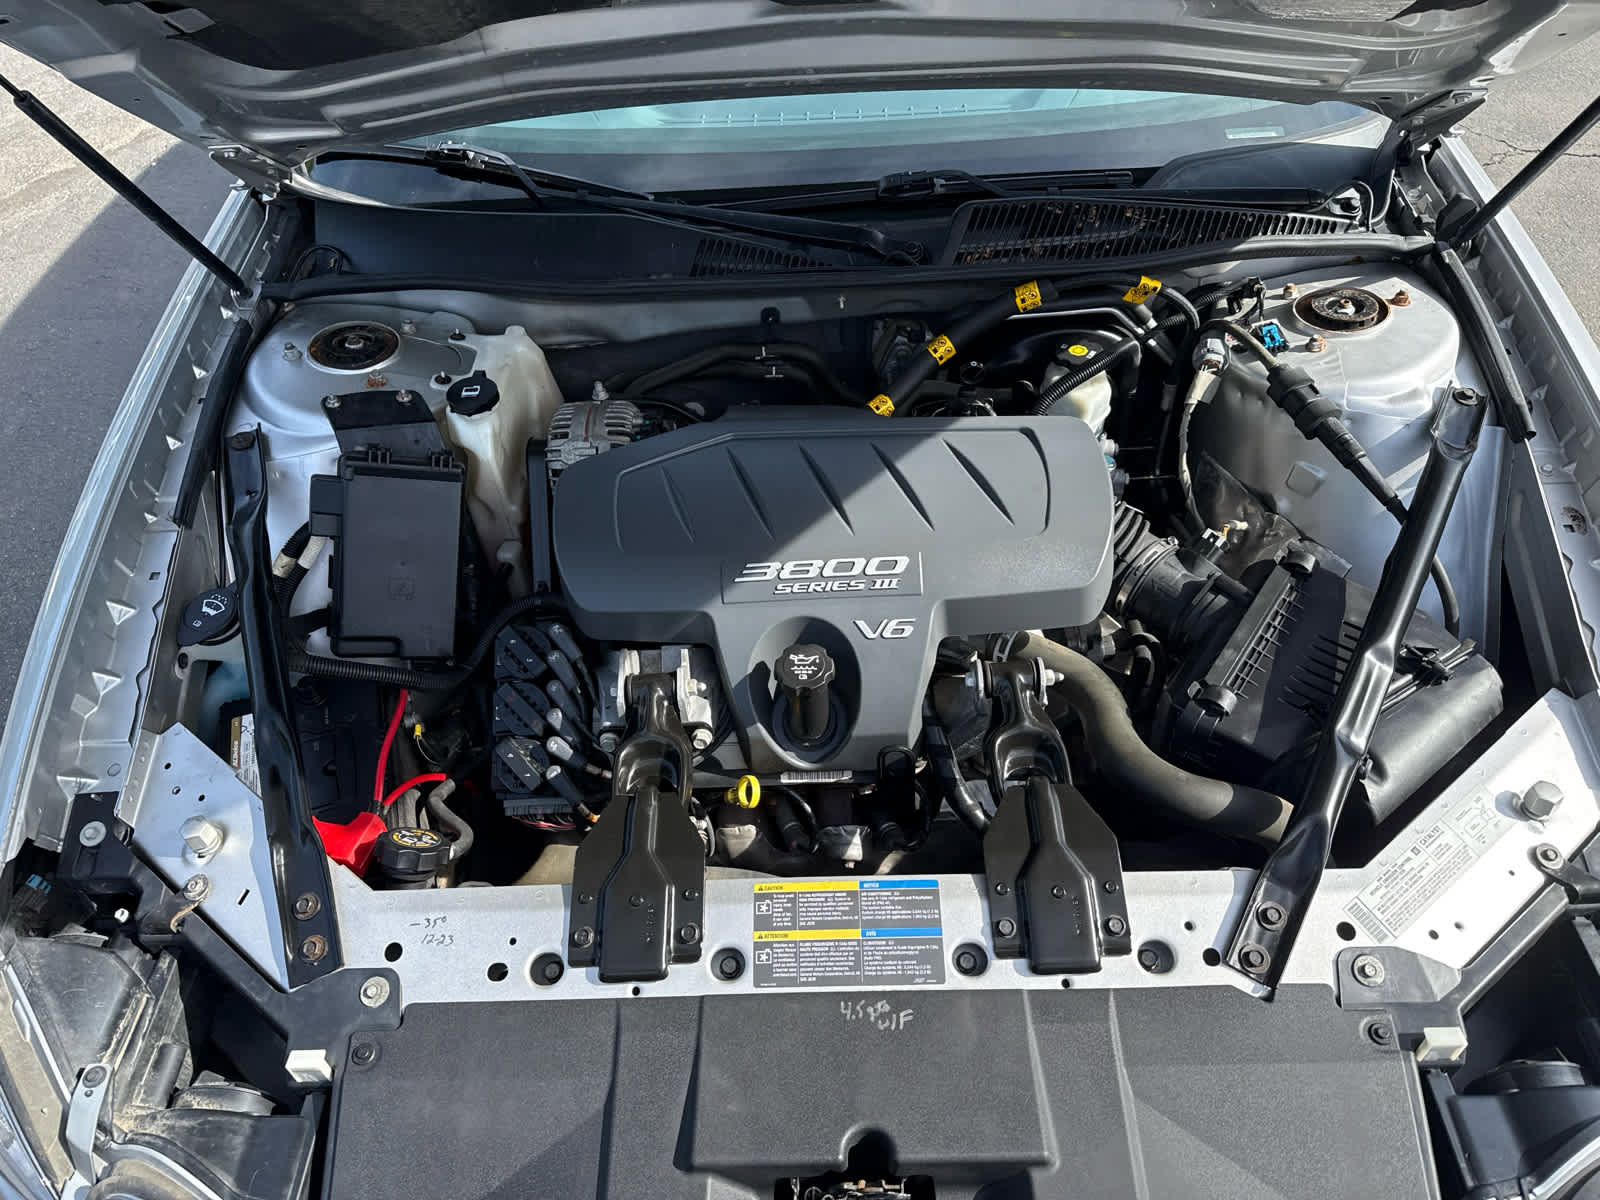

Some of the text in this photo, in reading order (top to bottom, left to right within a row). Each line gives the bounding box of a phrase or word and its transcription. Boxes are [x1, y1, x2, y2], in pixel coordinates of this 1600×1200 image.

[734, 556, 910, 582] 3800
[774, 578, 901, 595] SERIES III
[853, 618, 917, 640] V6
[421, 934, 454, 947] 12-23
